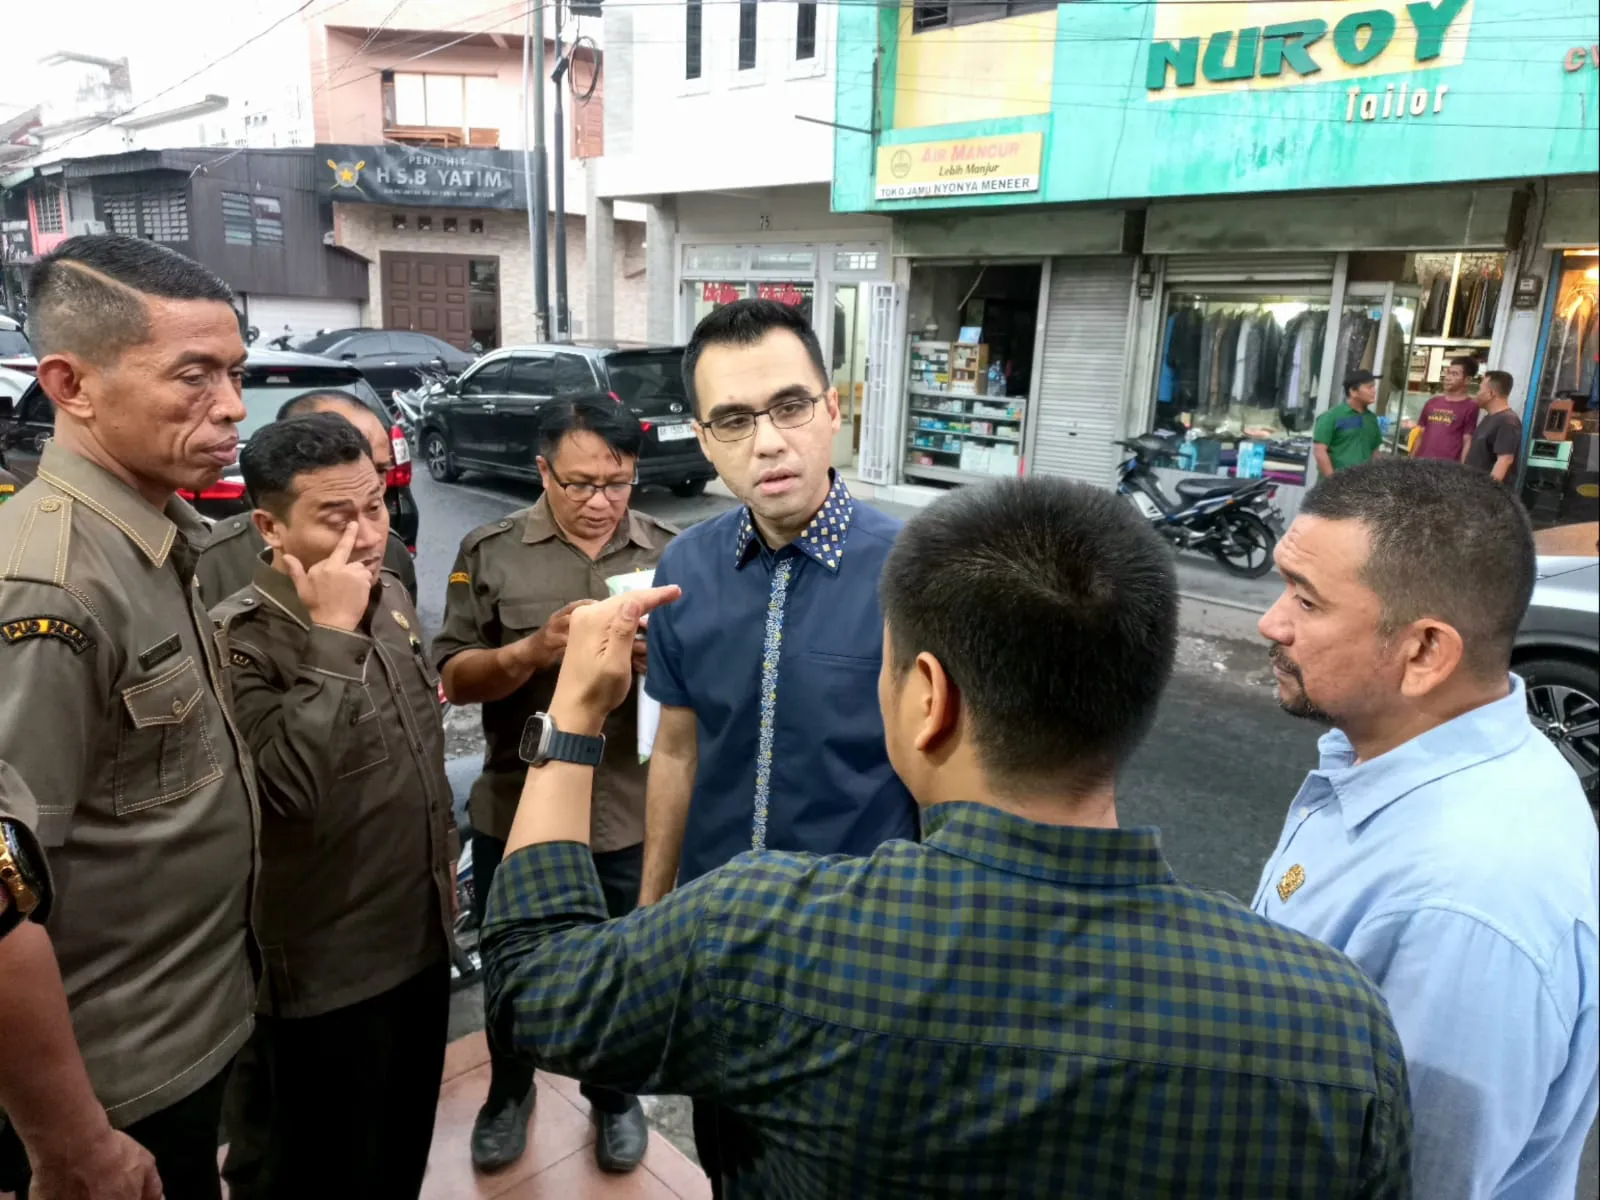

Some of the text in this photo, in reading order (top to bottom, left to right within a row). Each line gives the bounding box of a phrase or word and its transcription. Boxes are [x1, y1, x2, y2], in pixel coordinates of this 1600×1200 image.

[1146, 0, 1468, 90] NUROY
[1345, 83, 1449, 122] Tailor
[408, 155, 466, 166] PENJHIT
[938, 161, 1000, 176] Lebih Manjur
[438, 169, 502, 188] YATIM
[881, 177, 1030, 198] TOKO JAMU NYONYA MENEER
